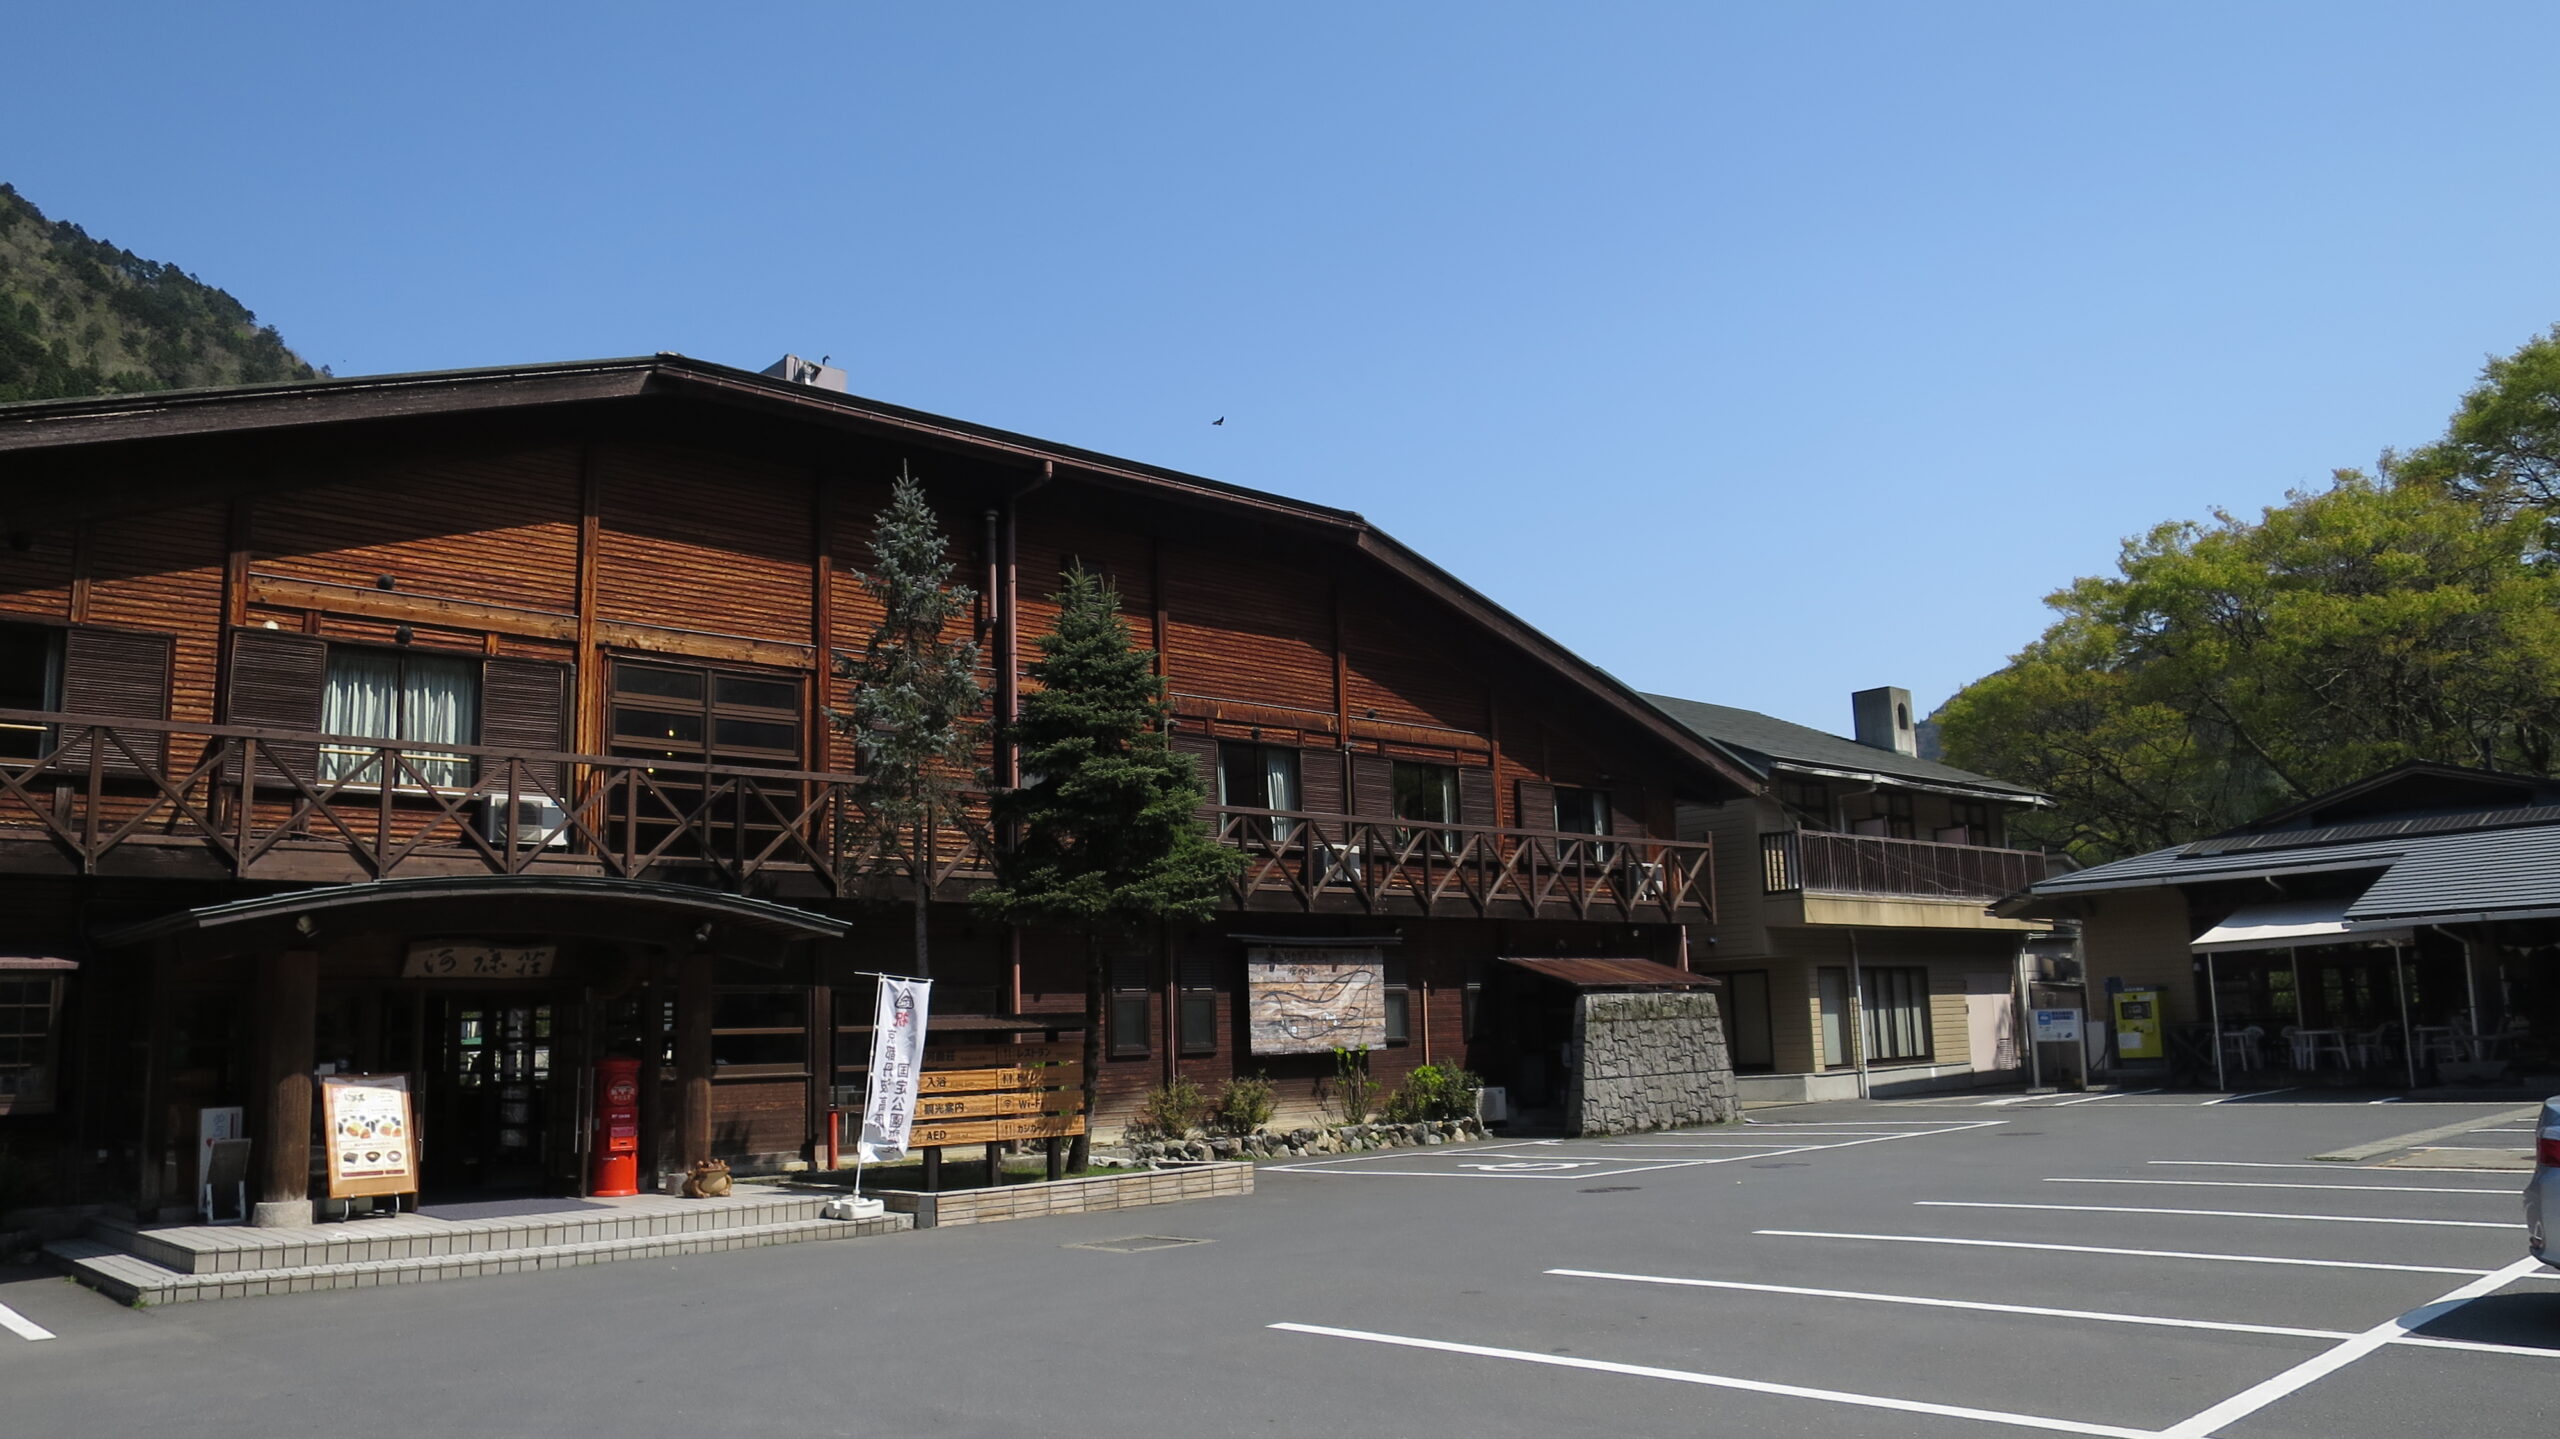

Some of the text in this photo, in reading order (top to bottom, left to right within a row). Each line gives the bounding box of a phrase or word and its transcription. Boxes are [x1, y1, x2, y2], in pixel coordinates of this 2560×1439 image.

[926, 1077, 947, 1087] 入浴
[924, 1102, 965, 1115] 観光案内
[1019, 1098, 1044, 1109] Wi-Fi
[926, 1130, 947, 1141] AED
